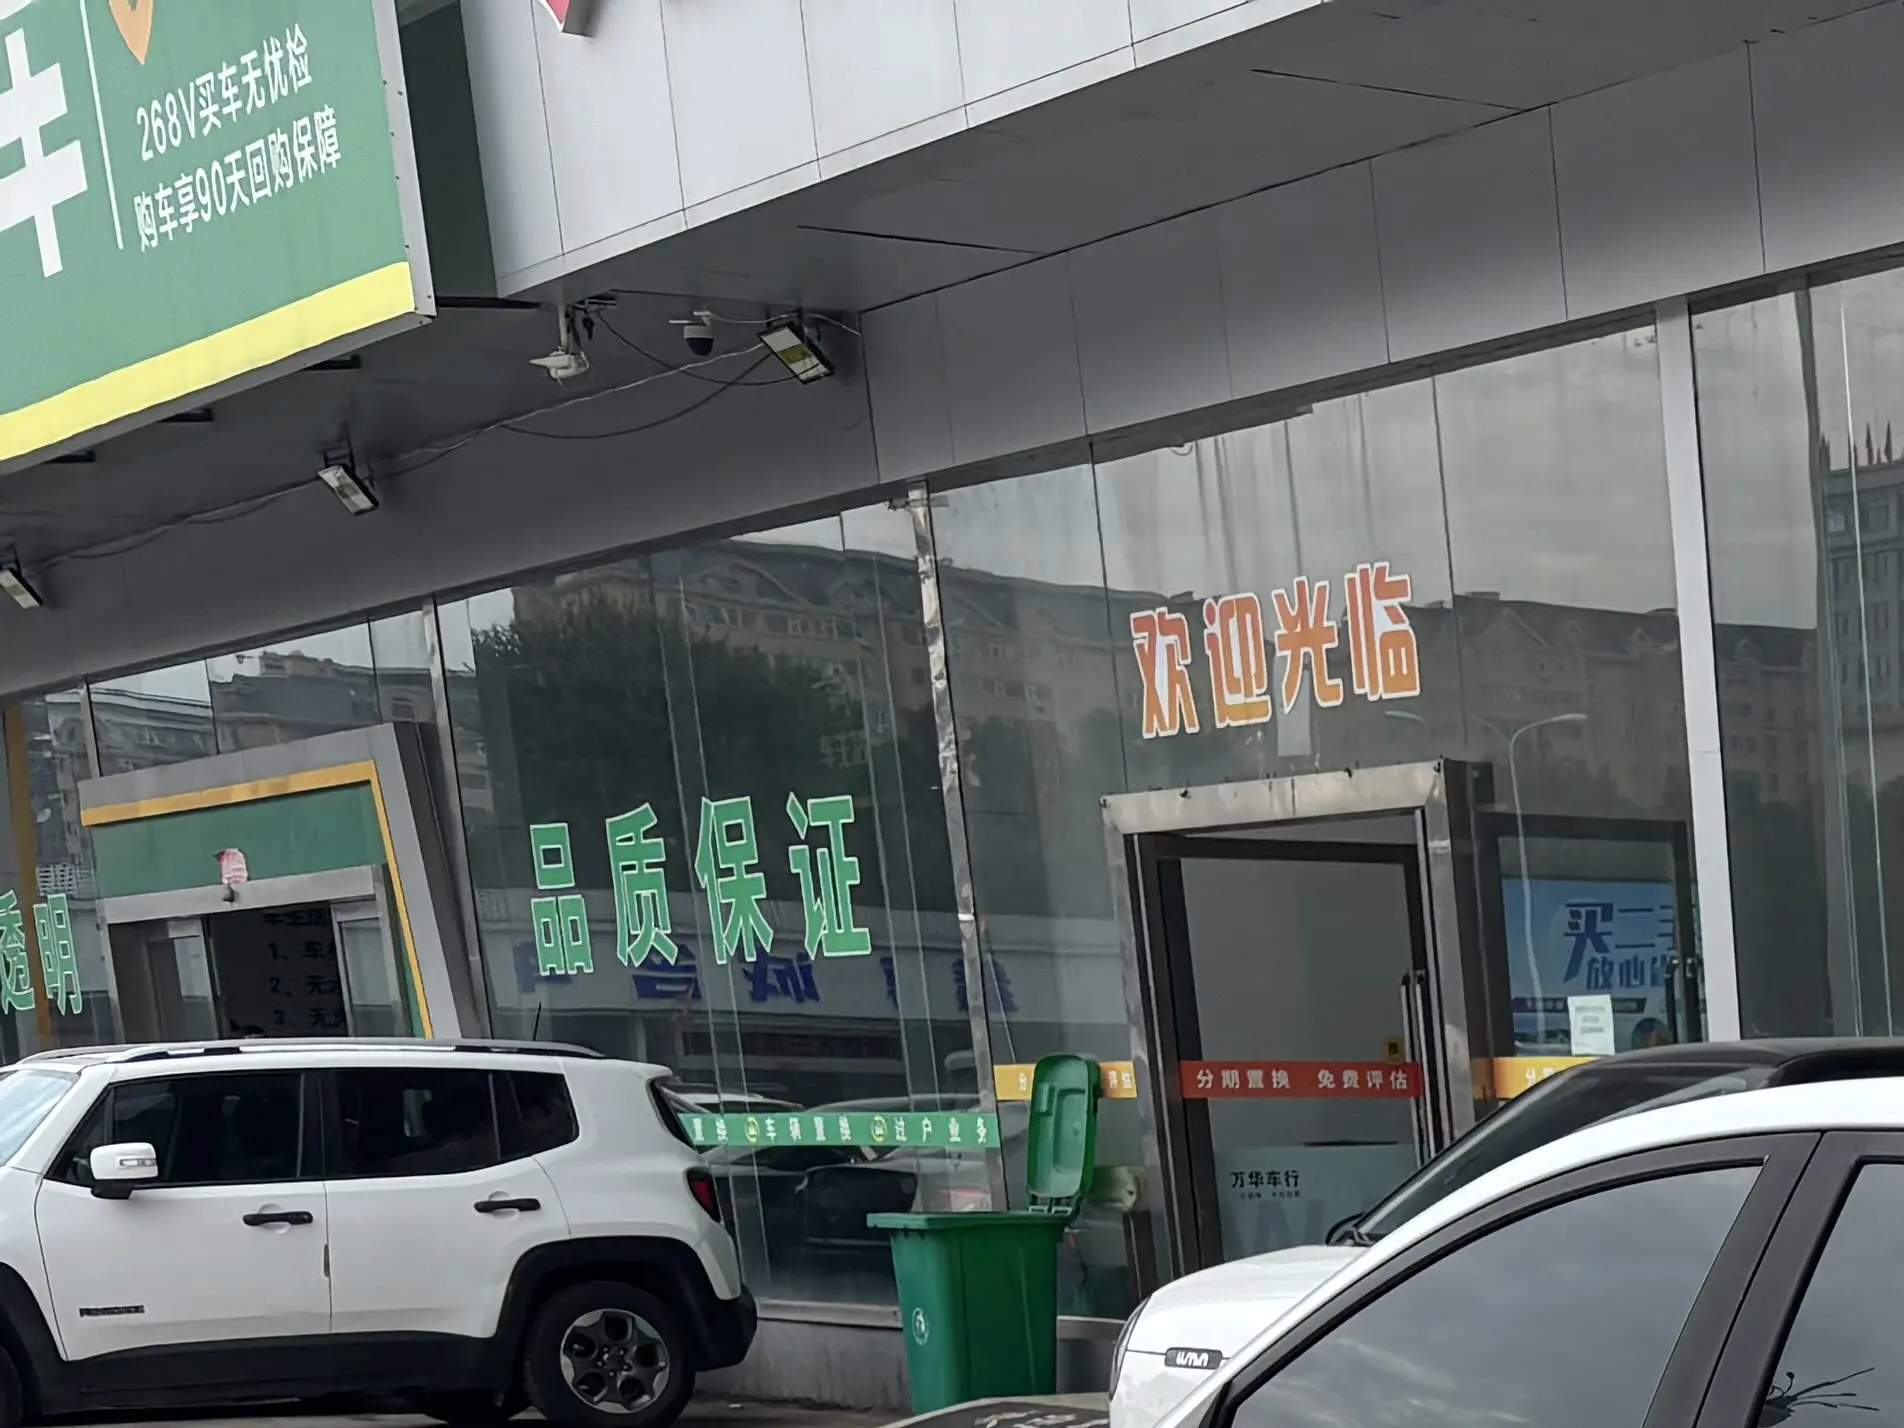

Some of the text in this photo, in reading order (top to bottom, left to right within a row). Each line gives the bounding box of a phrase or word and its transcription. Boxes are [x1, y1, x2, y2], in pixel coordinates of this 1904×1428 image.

[133, 104, 341, 252] 购车享90天回购保障
[1130, 561, 1421, 739] 欢迎光临
[529, 791, 872, 976] 品质保证
[1196, 1068, 1408, 1091] 分期置换 免费评估
[1229, 1169, 1300, 1188] 万华车行
